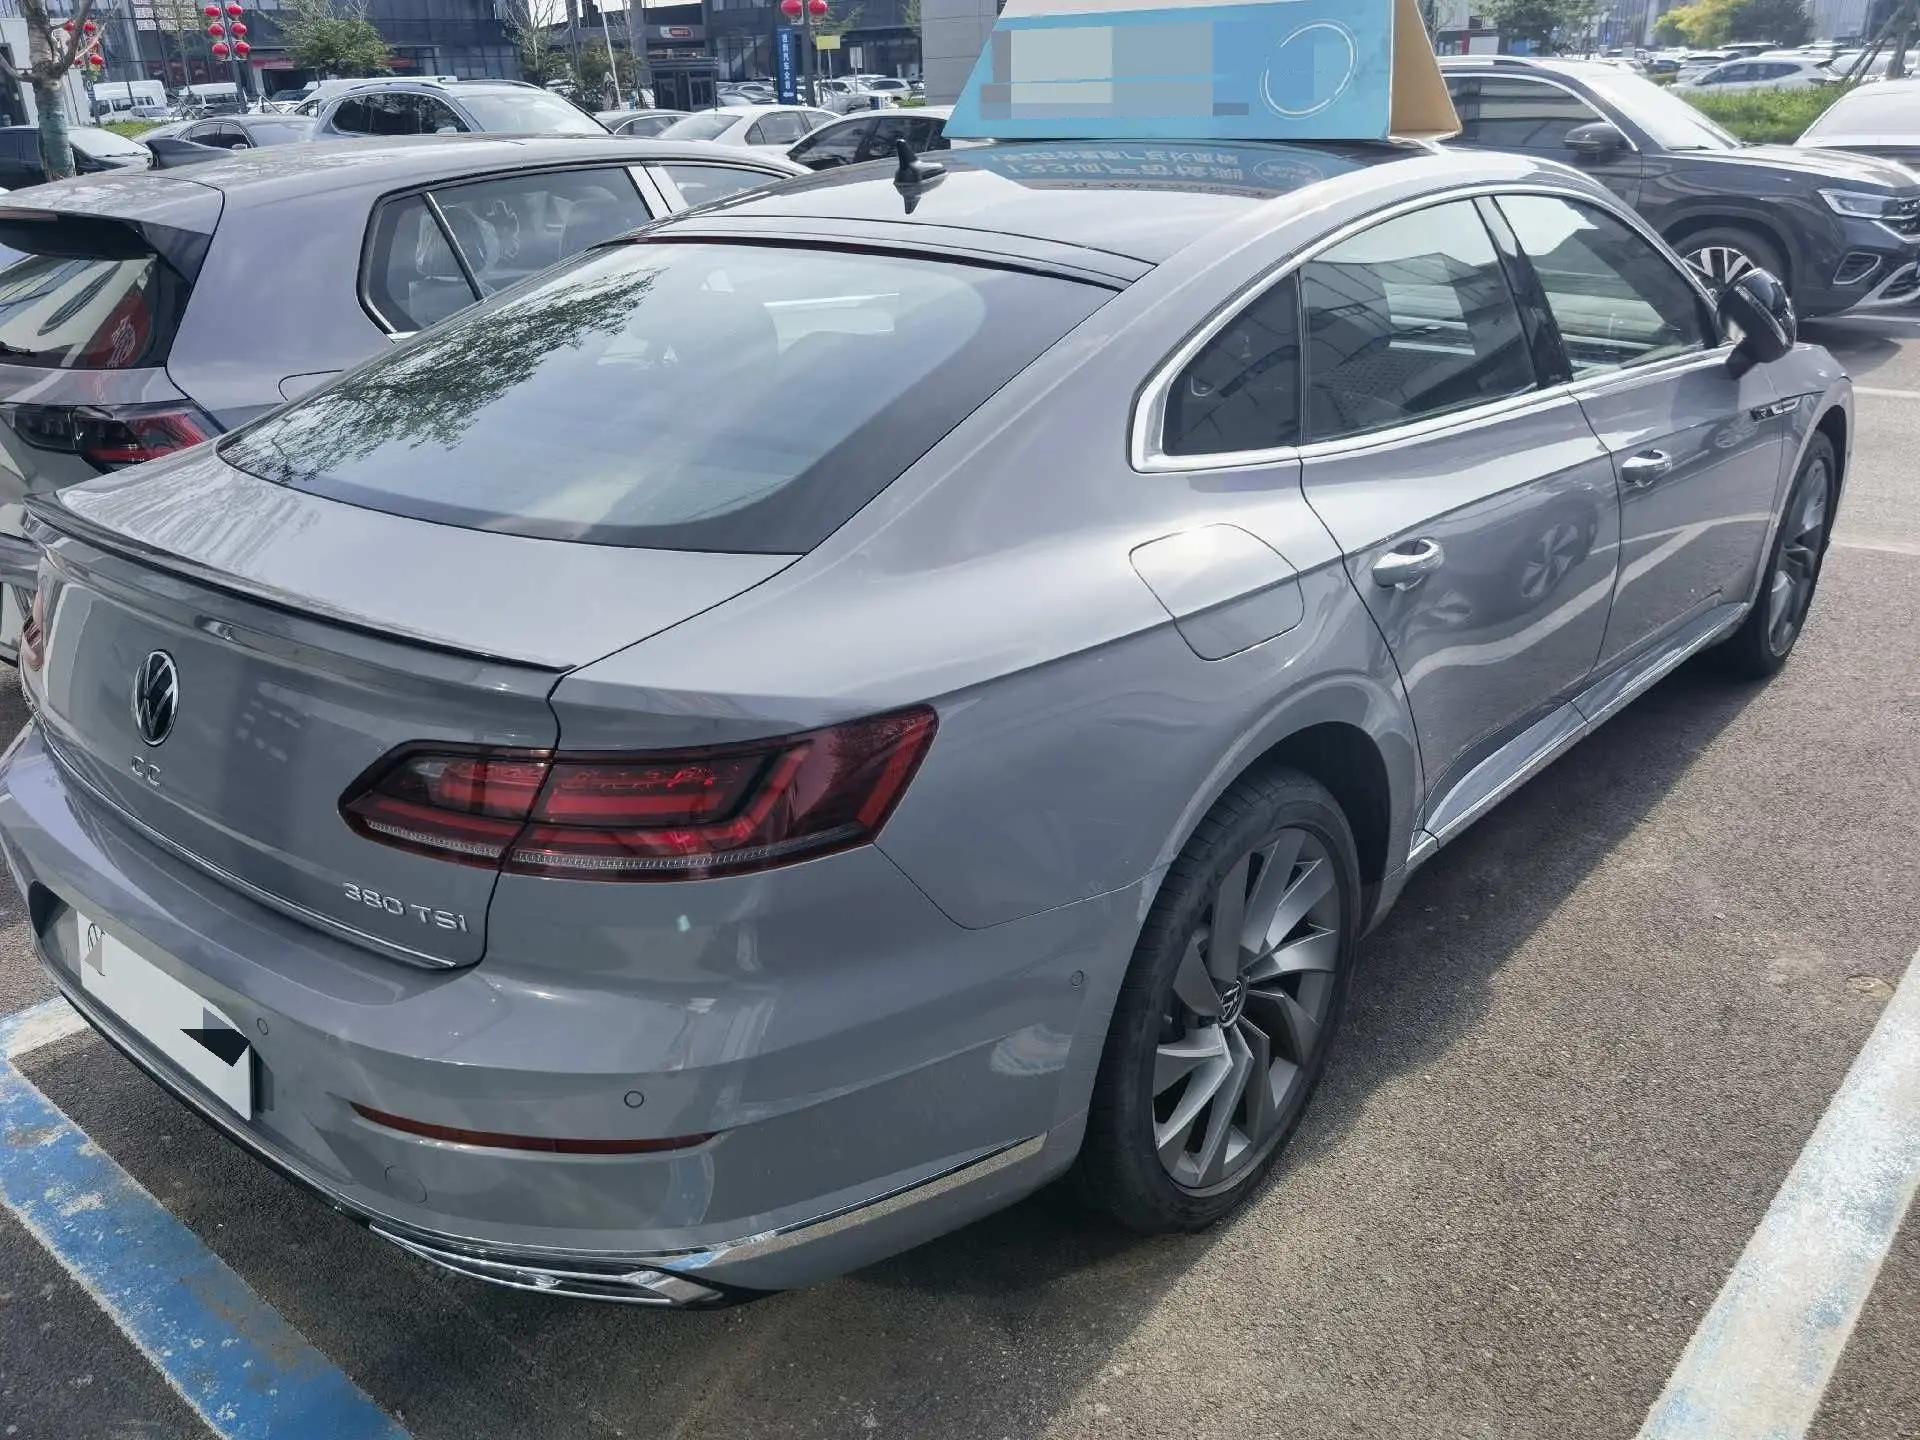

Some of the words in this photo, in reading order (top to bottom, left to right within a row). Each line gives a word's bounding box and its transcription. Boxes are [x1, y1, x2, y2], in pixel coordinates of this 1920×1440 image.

[131, 755, 161, 786] CC
[342, 882, 405, 915] 380
[409, 903, 469, 933] TSI
